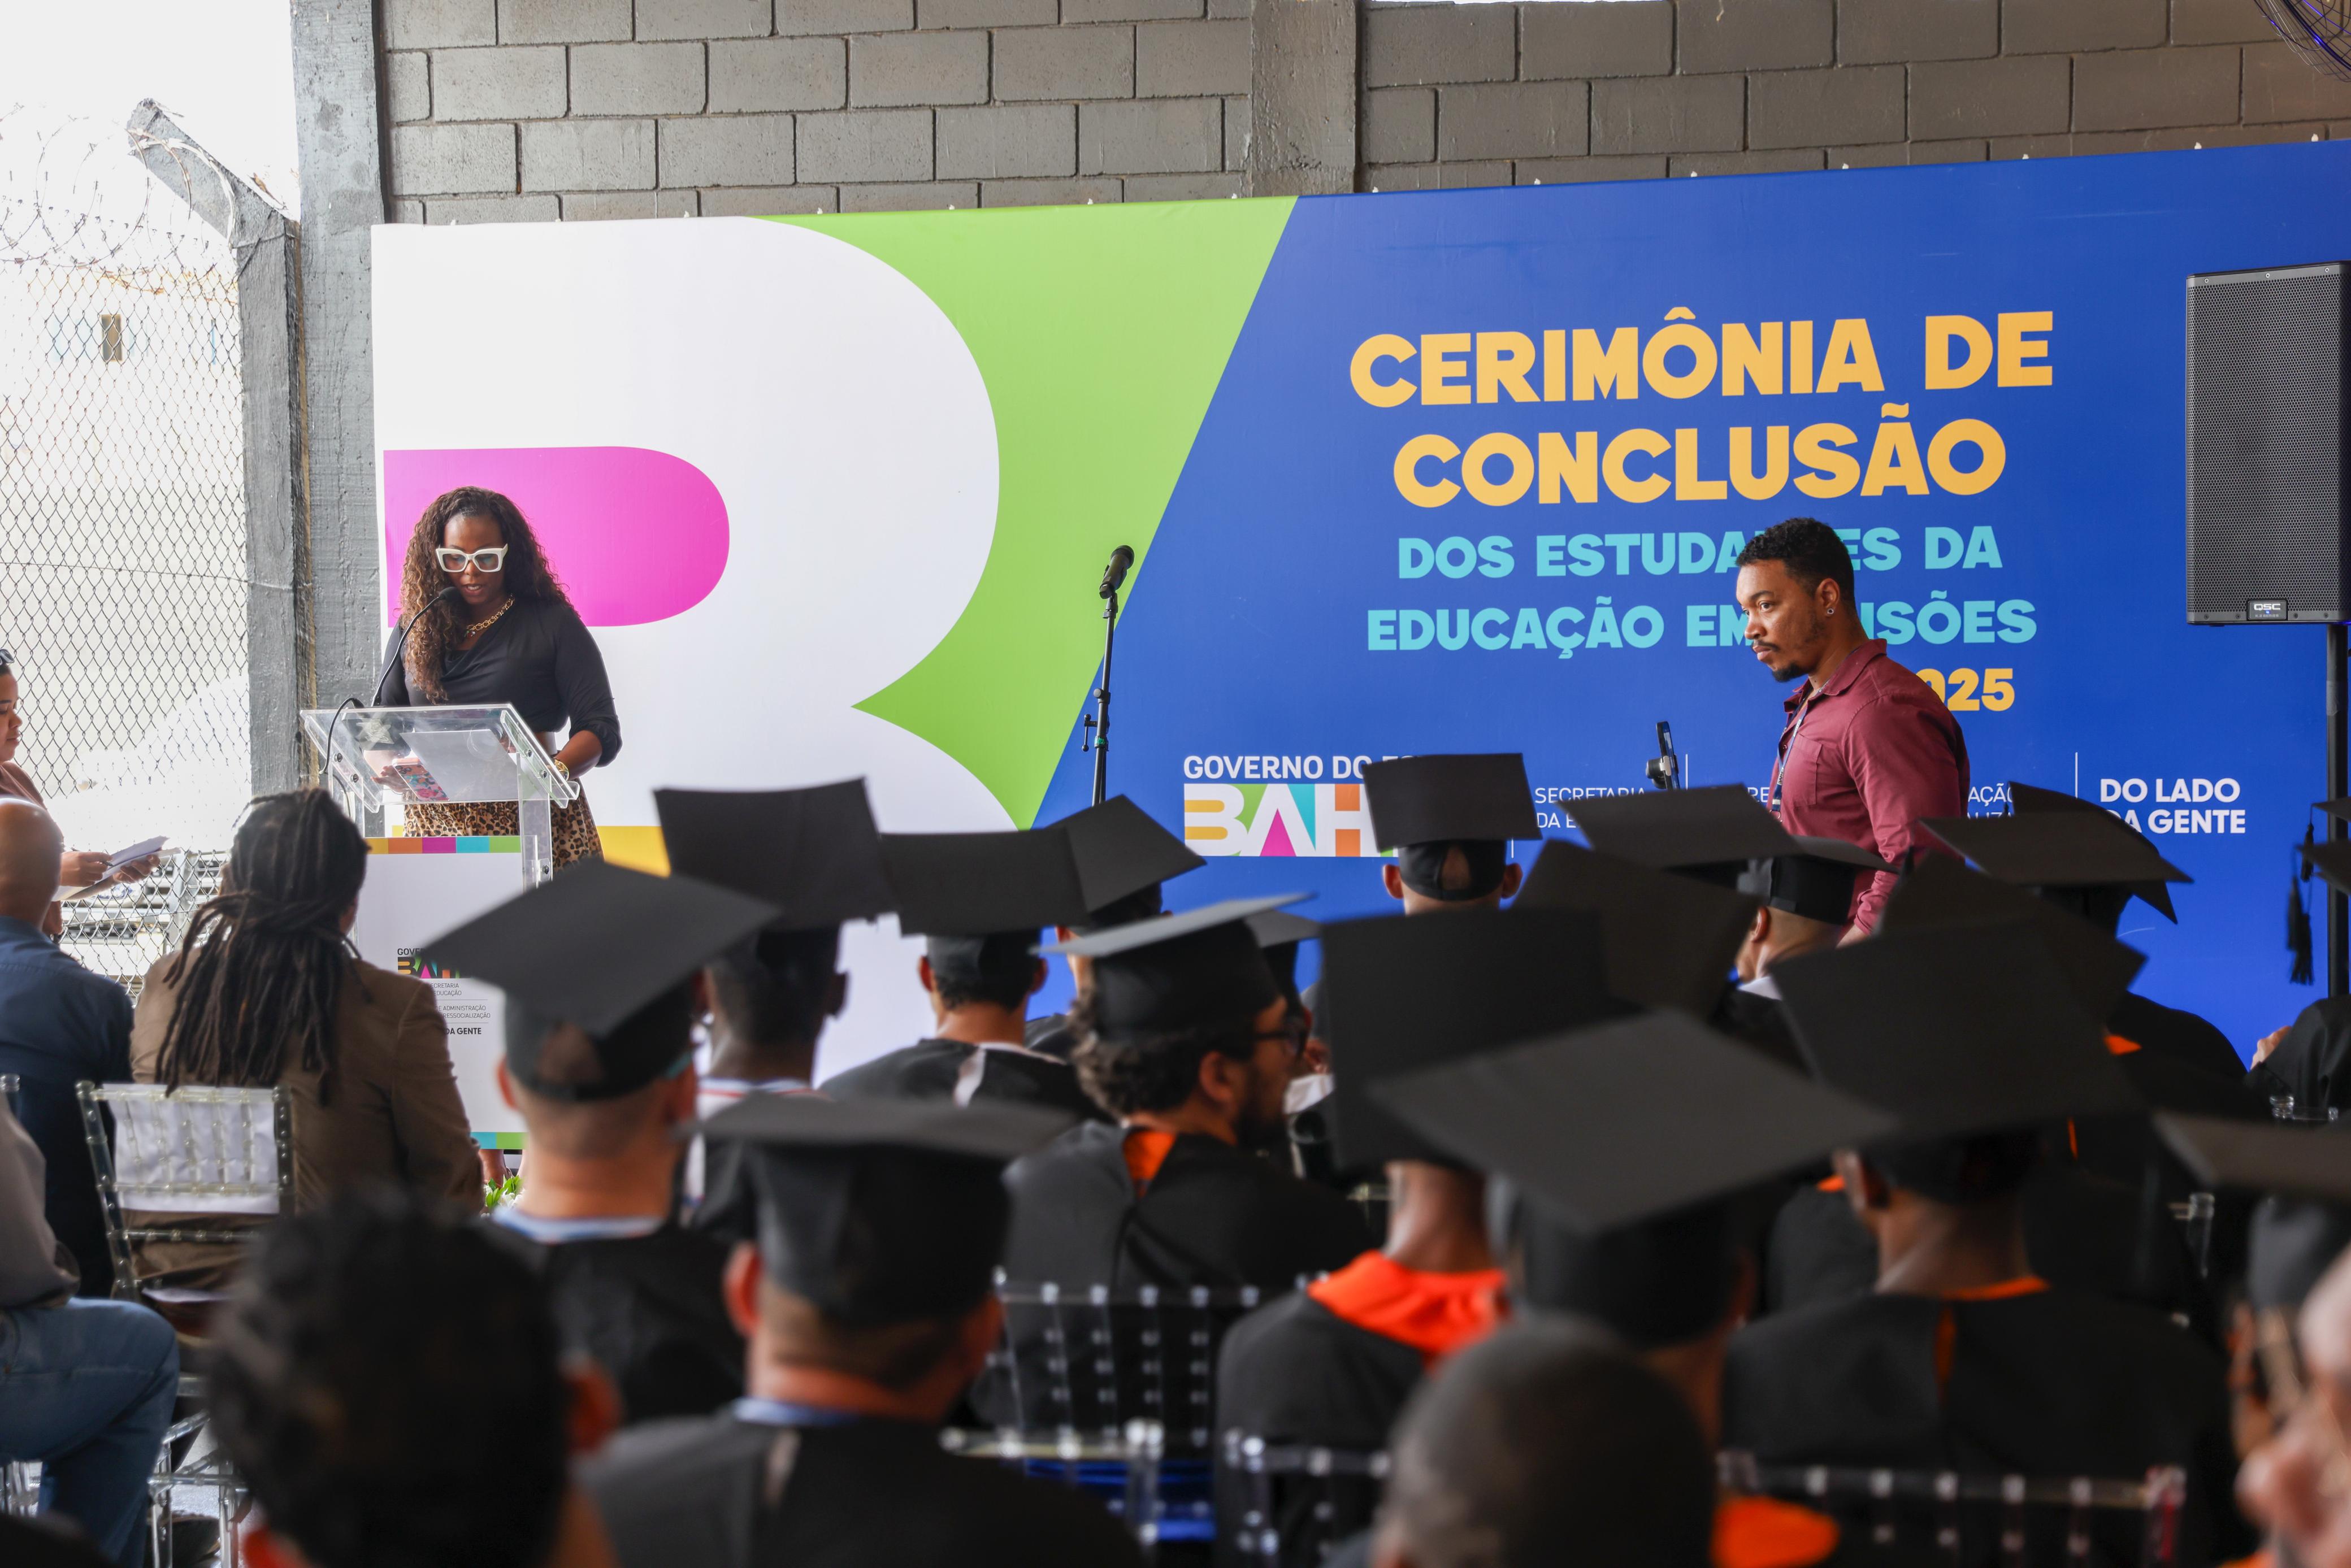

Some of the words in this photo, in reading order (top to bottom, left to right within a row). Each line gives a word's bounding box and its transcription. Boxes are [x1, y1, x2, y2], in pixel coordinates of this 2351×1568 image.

[1350, 307, 1885, 408] CERIMÔNIA
[1925, 311, 2053, 390] DE
[1394, 403, 2006, 507] CONCLUSÃO
[1399, 535, 1515, 579] DOS
[1536, 527, 1902, 577] ESTUDAES
[1925, 525, 2003, 569] DA
[1367, 597, 1664, 659] EDUCAÇÃO
[1686, 605, 1754, 647] EM
[1860, 590, 2037, 645] ISÕES
[1916, 668, 2015, 711] 025
[1183, 755, 1324, 779] GOVERNO
[1333, 755, 1372, 779] DO
[2100, 778, 2148, 802] DO
[2155, 778, 2240, 803] LADO
[1183, 783, 1398, 857] BAH
[1537, 813, 1561, 828] DA
[2148, 809, 2245, 833] GENTE
